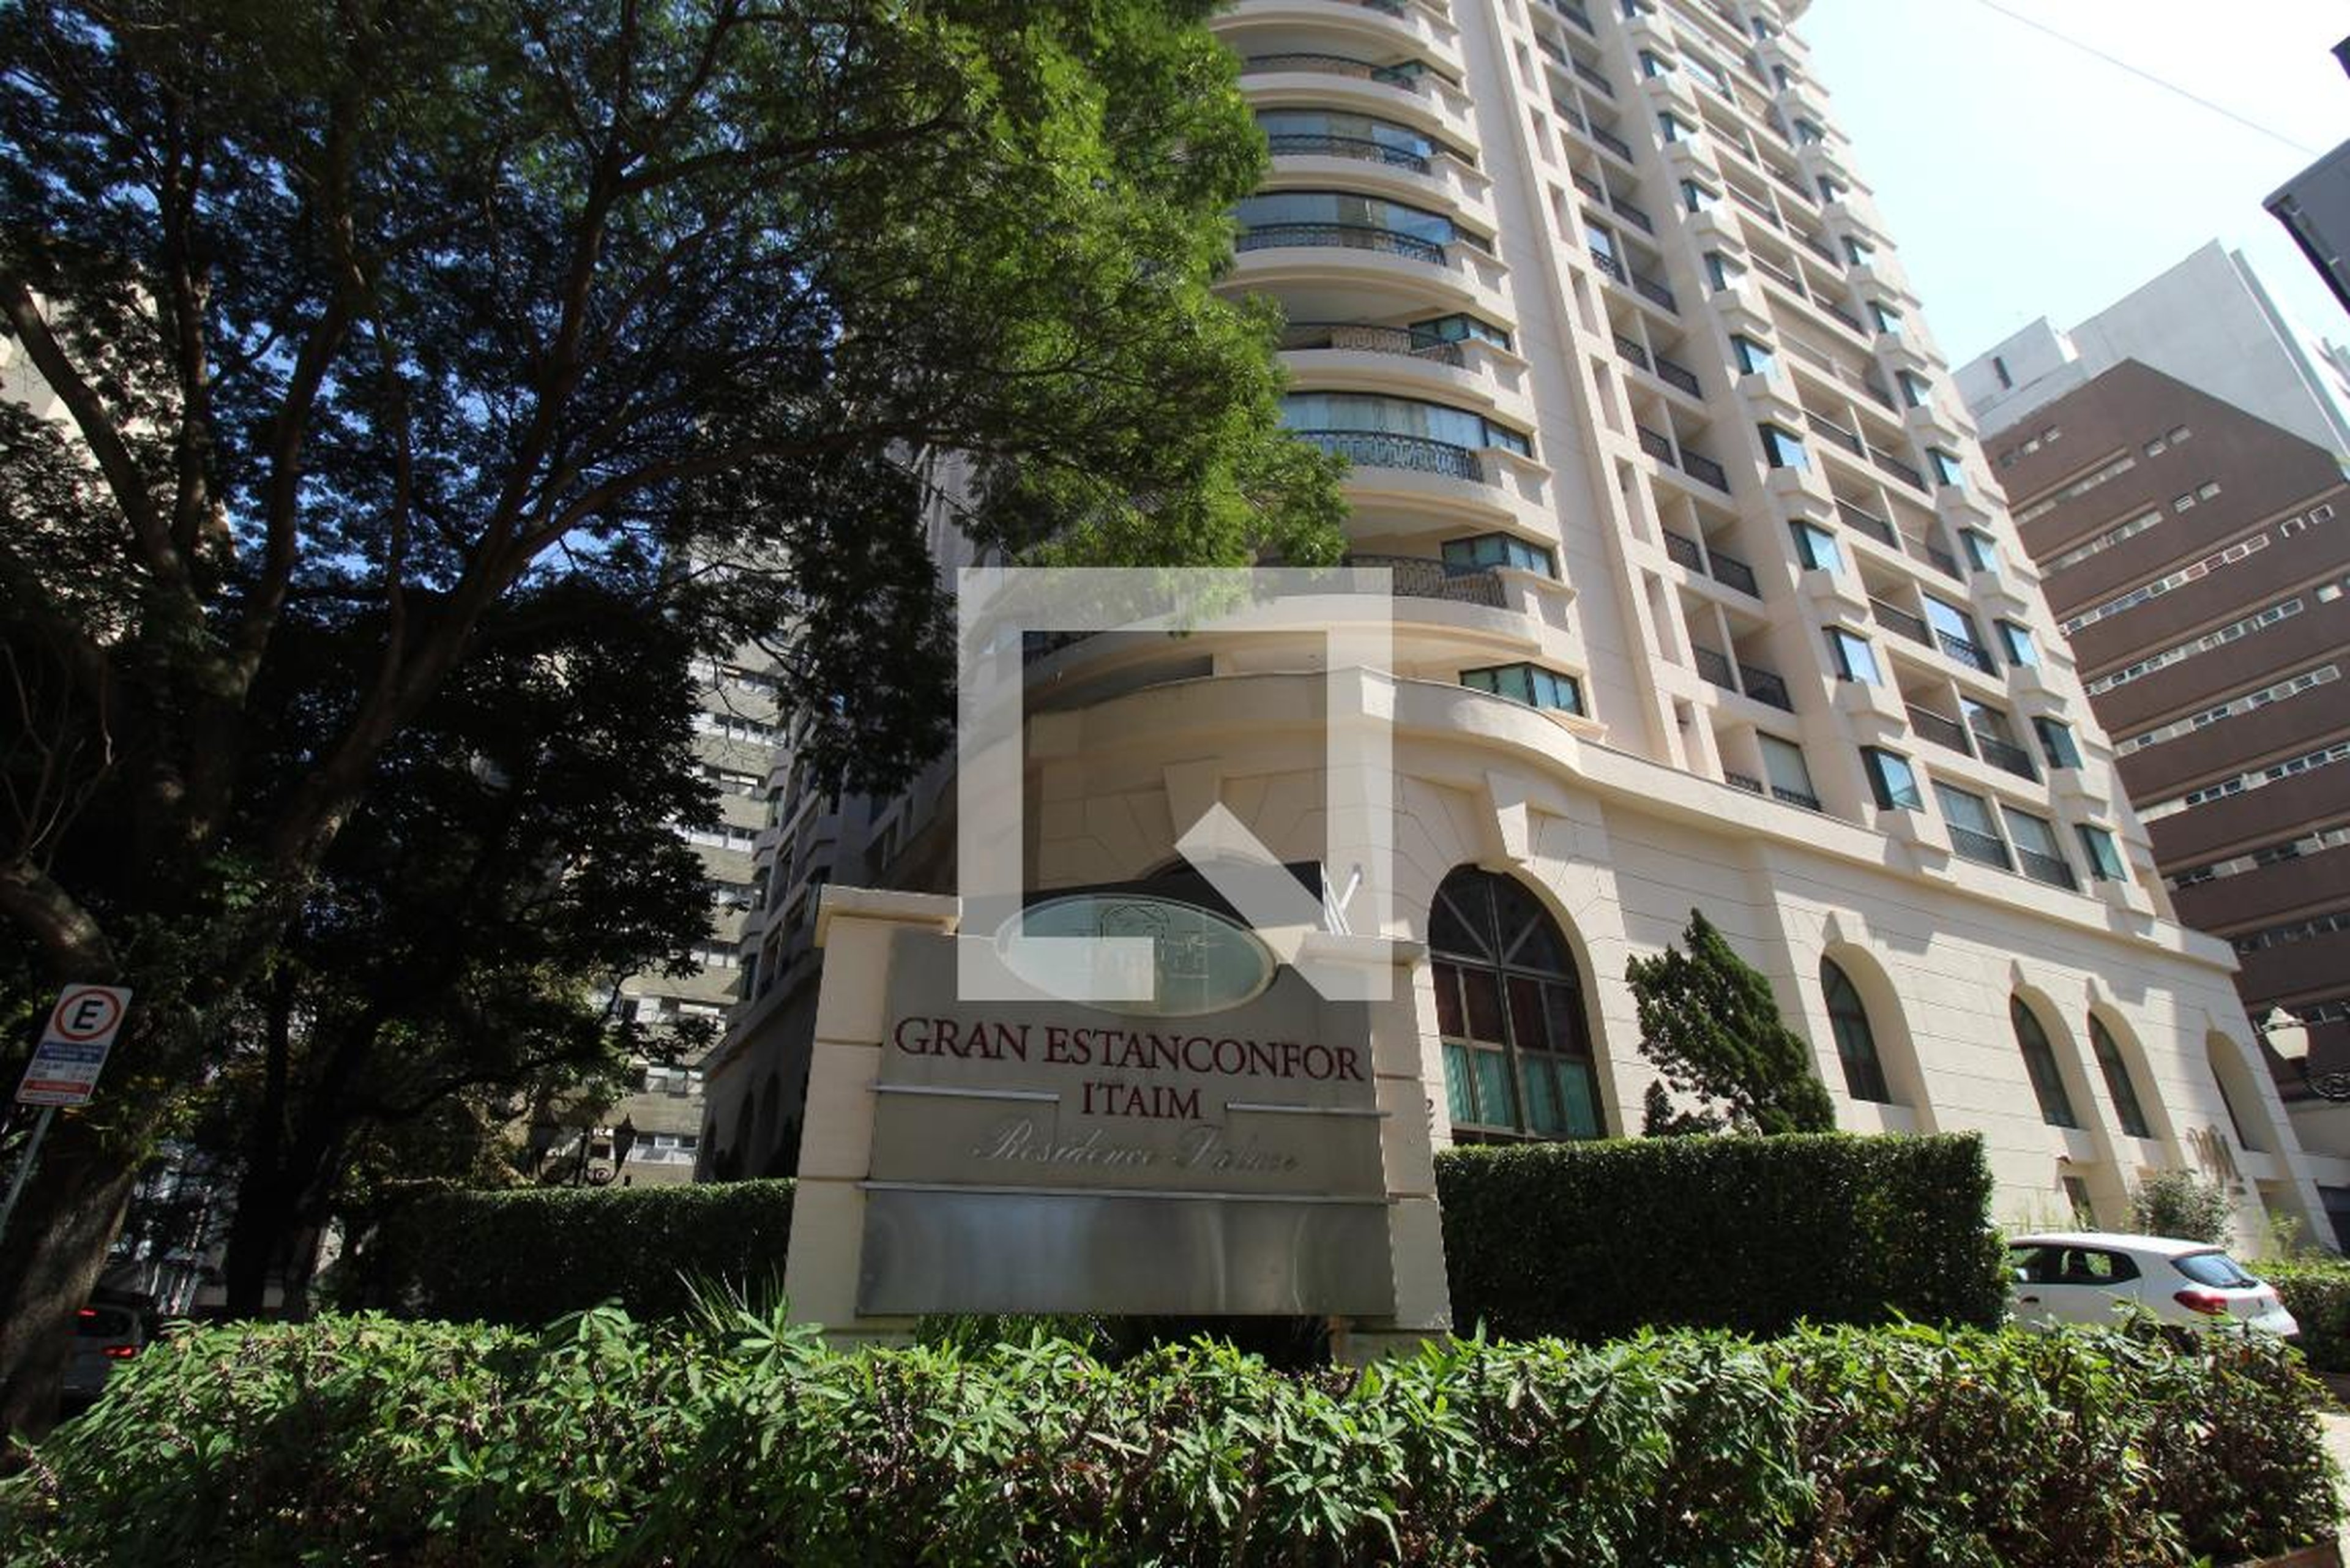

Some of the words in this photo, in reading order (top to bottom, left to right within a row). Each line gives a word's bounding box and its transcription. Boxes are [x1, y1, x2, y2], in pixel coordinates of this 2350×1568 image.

[73, 999, 103, 1029] E
[894, 1017, 1032, 1062] GRAN
[1043, 1026, 1365, 1081] ESTANCONFOR
[1081, 1080, 1204, 1120] ITAIM
